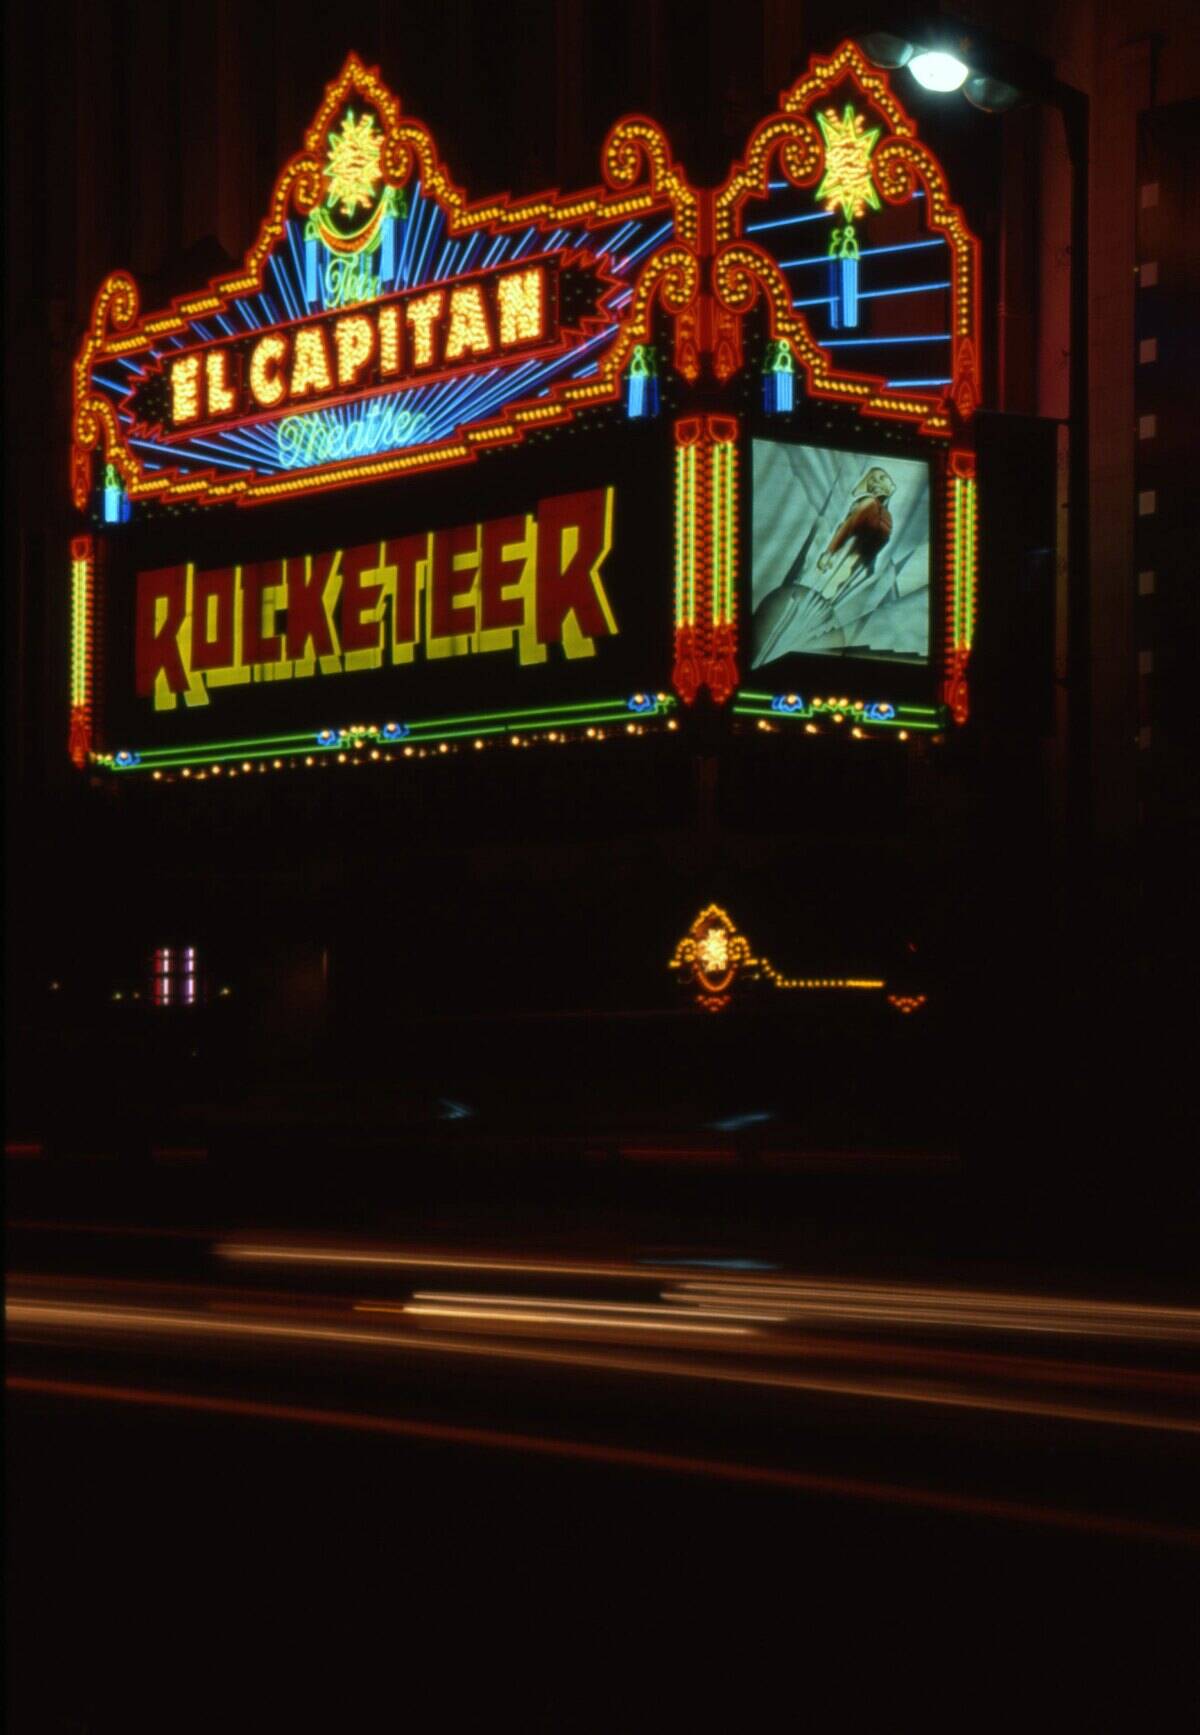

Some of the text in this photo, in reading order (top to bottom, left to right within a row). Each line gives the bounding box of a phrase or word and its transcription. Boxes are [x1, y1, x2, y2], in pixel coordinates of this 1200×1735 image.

[169, 266, 544, 424] EL CAPITAN
[135, 485, 620, 711] ROCKETEER
